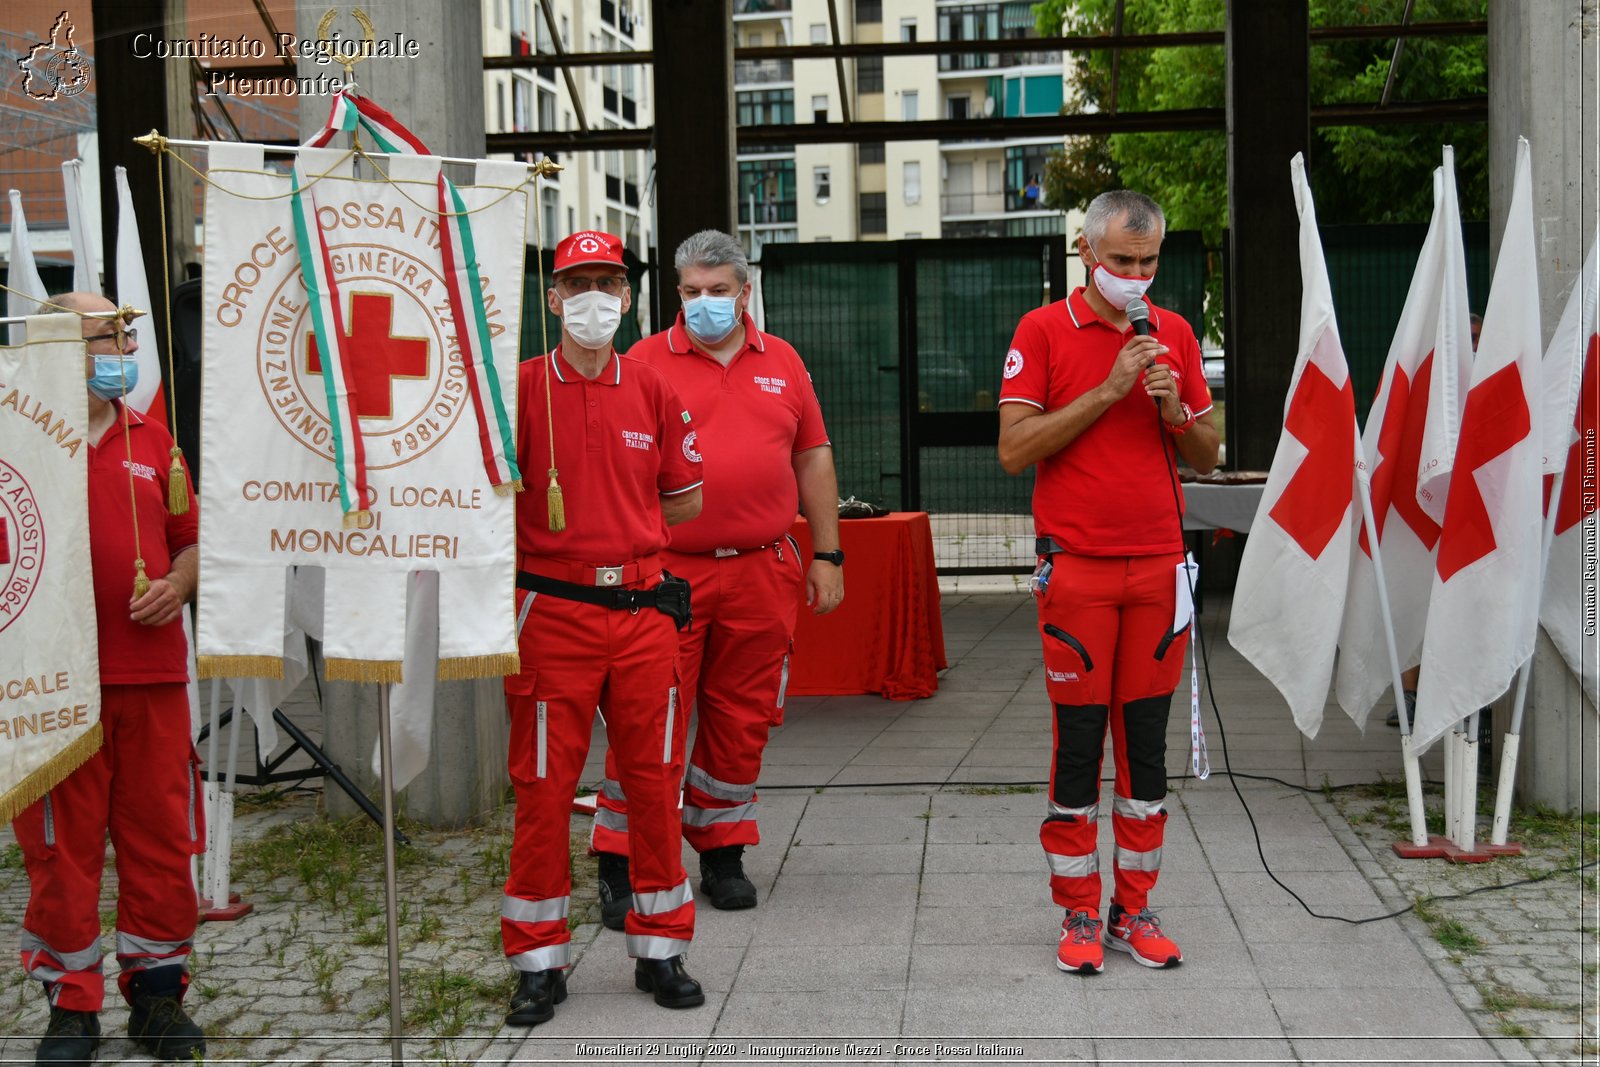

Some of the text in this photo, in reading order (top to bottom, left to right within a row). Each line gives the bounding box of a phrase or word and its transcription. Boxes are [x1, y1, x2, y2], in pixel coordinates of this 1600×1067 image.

[217, 226, 295, 327] CROCE
[317, 202, 405, 233] OSSA
[265, 295, 337, 453] ONVENZIONE
[331, 251, 433, 296] GINEVRA
[392, 418, 440, 457] 1864
[242, 480, 483, 509] COMITAO LOCALE
[357, 510, 382, 531] DI
[7, 486, 39, 571] AGOSTO
[270, 528, 460, 559] MONCALIERI
